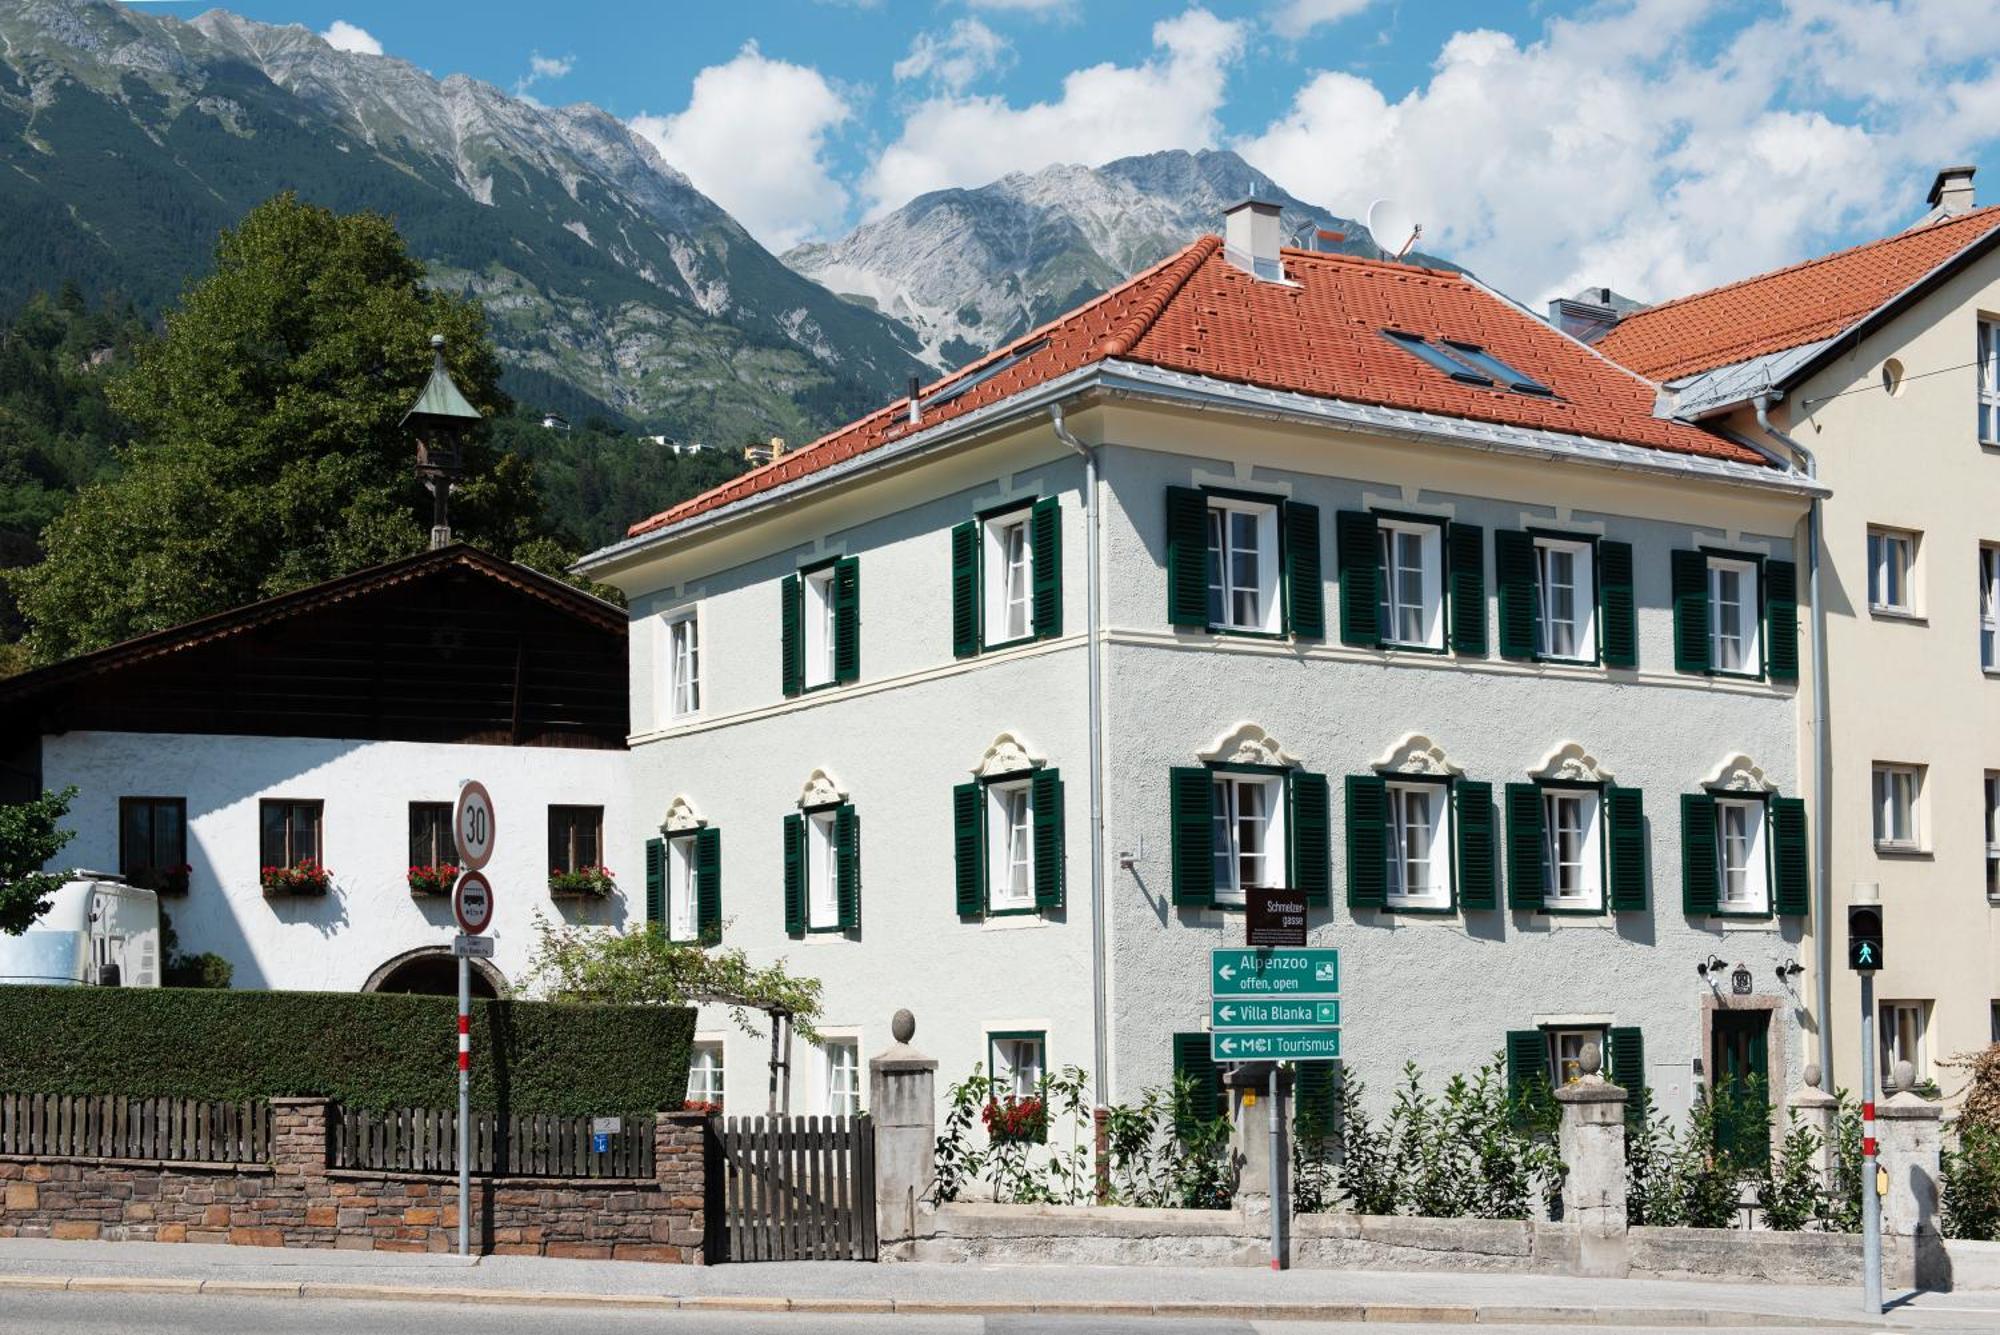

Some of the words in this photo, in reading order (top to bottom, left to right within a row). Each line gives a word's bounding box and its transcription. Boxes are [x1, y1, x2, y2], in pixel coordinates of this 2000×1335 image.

[466, 805, 485, 846] 30
[1282, 916, 1304, 928] gasse
[1240, 955, 1308, 972] Alpenzoo
[1240, 977, 1271, 991] offen,
[1273, 979, 1299, 992] open
[1240, 1005, 1268, 1021] Villa
[1271, 1006, 1312, 1020] Blanka
[1241, 1038, 1272, 1052] MCI
[1277, 1036, 1335, 1052] Tourismus
